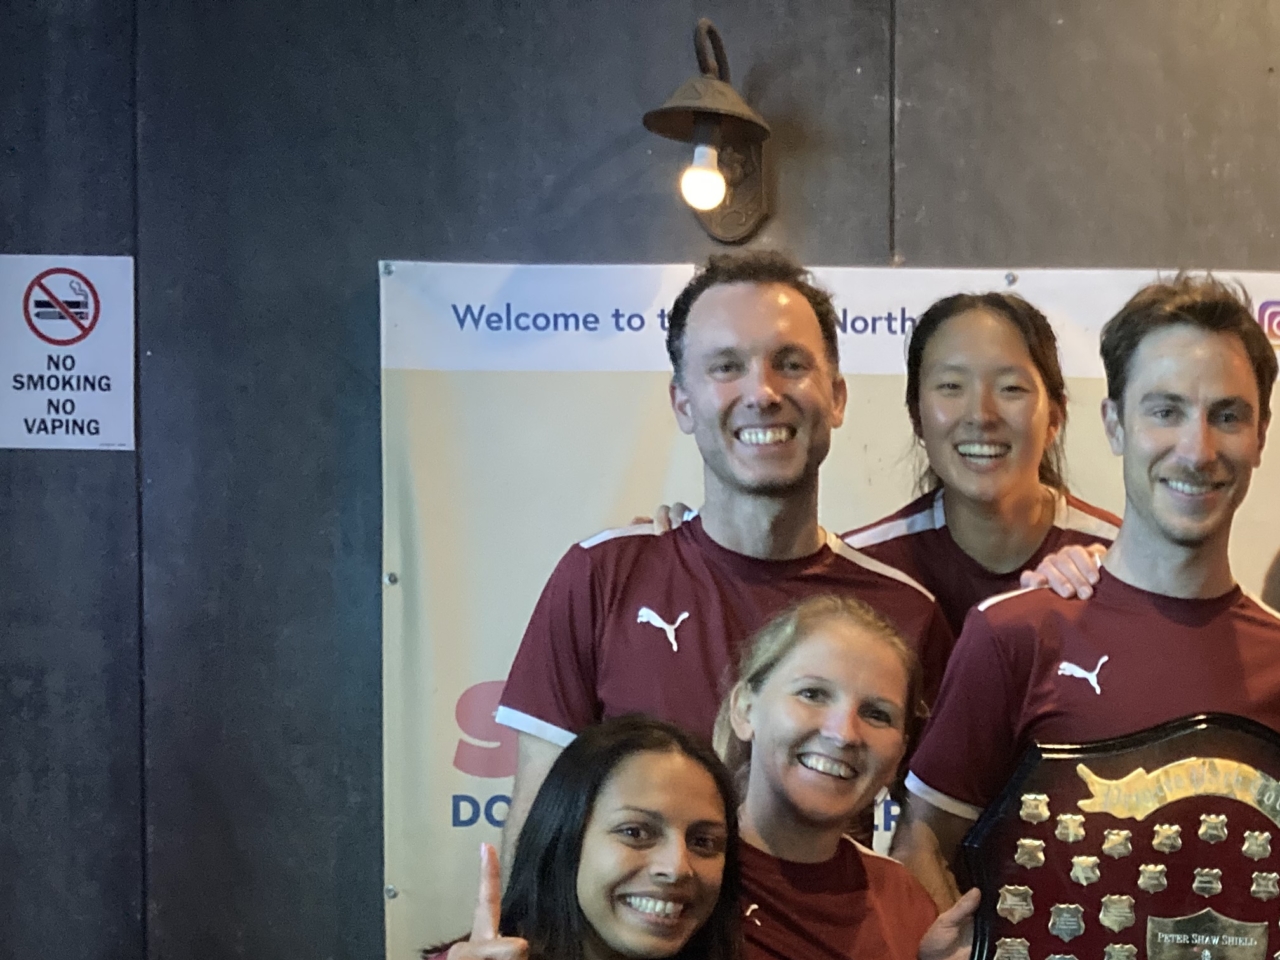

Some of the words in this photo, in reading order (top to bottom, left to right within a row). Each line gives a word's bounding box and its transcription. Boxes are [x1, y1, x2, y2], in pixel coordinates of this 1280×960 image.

[451, 302, 600, 332] Welcome
[611, 308, 645, 332] to
[46, 354, 76, 372] NO
[12, 373, 112, 392] SMOKING
[46, 398, 76, 416] NO
[23, 417, 101, 436] VAPING
